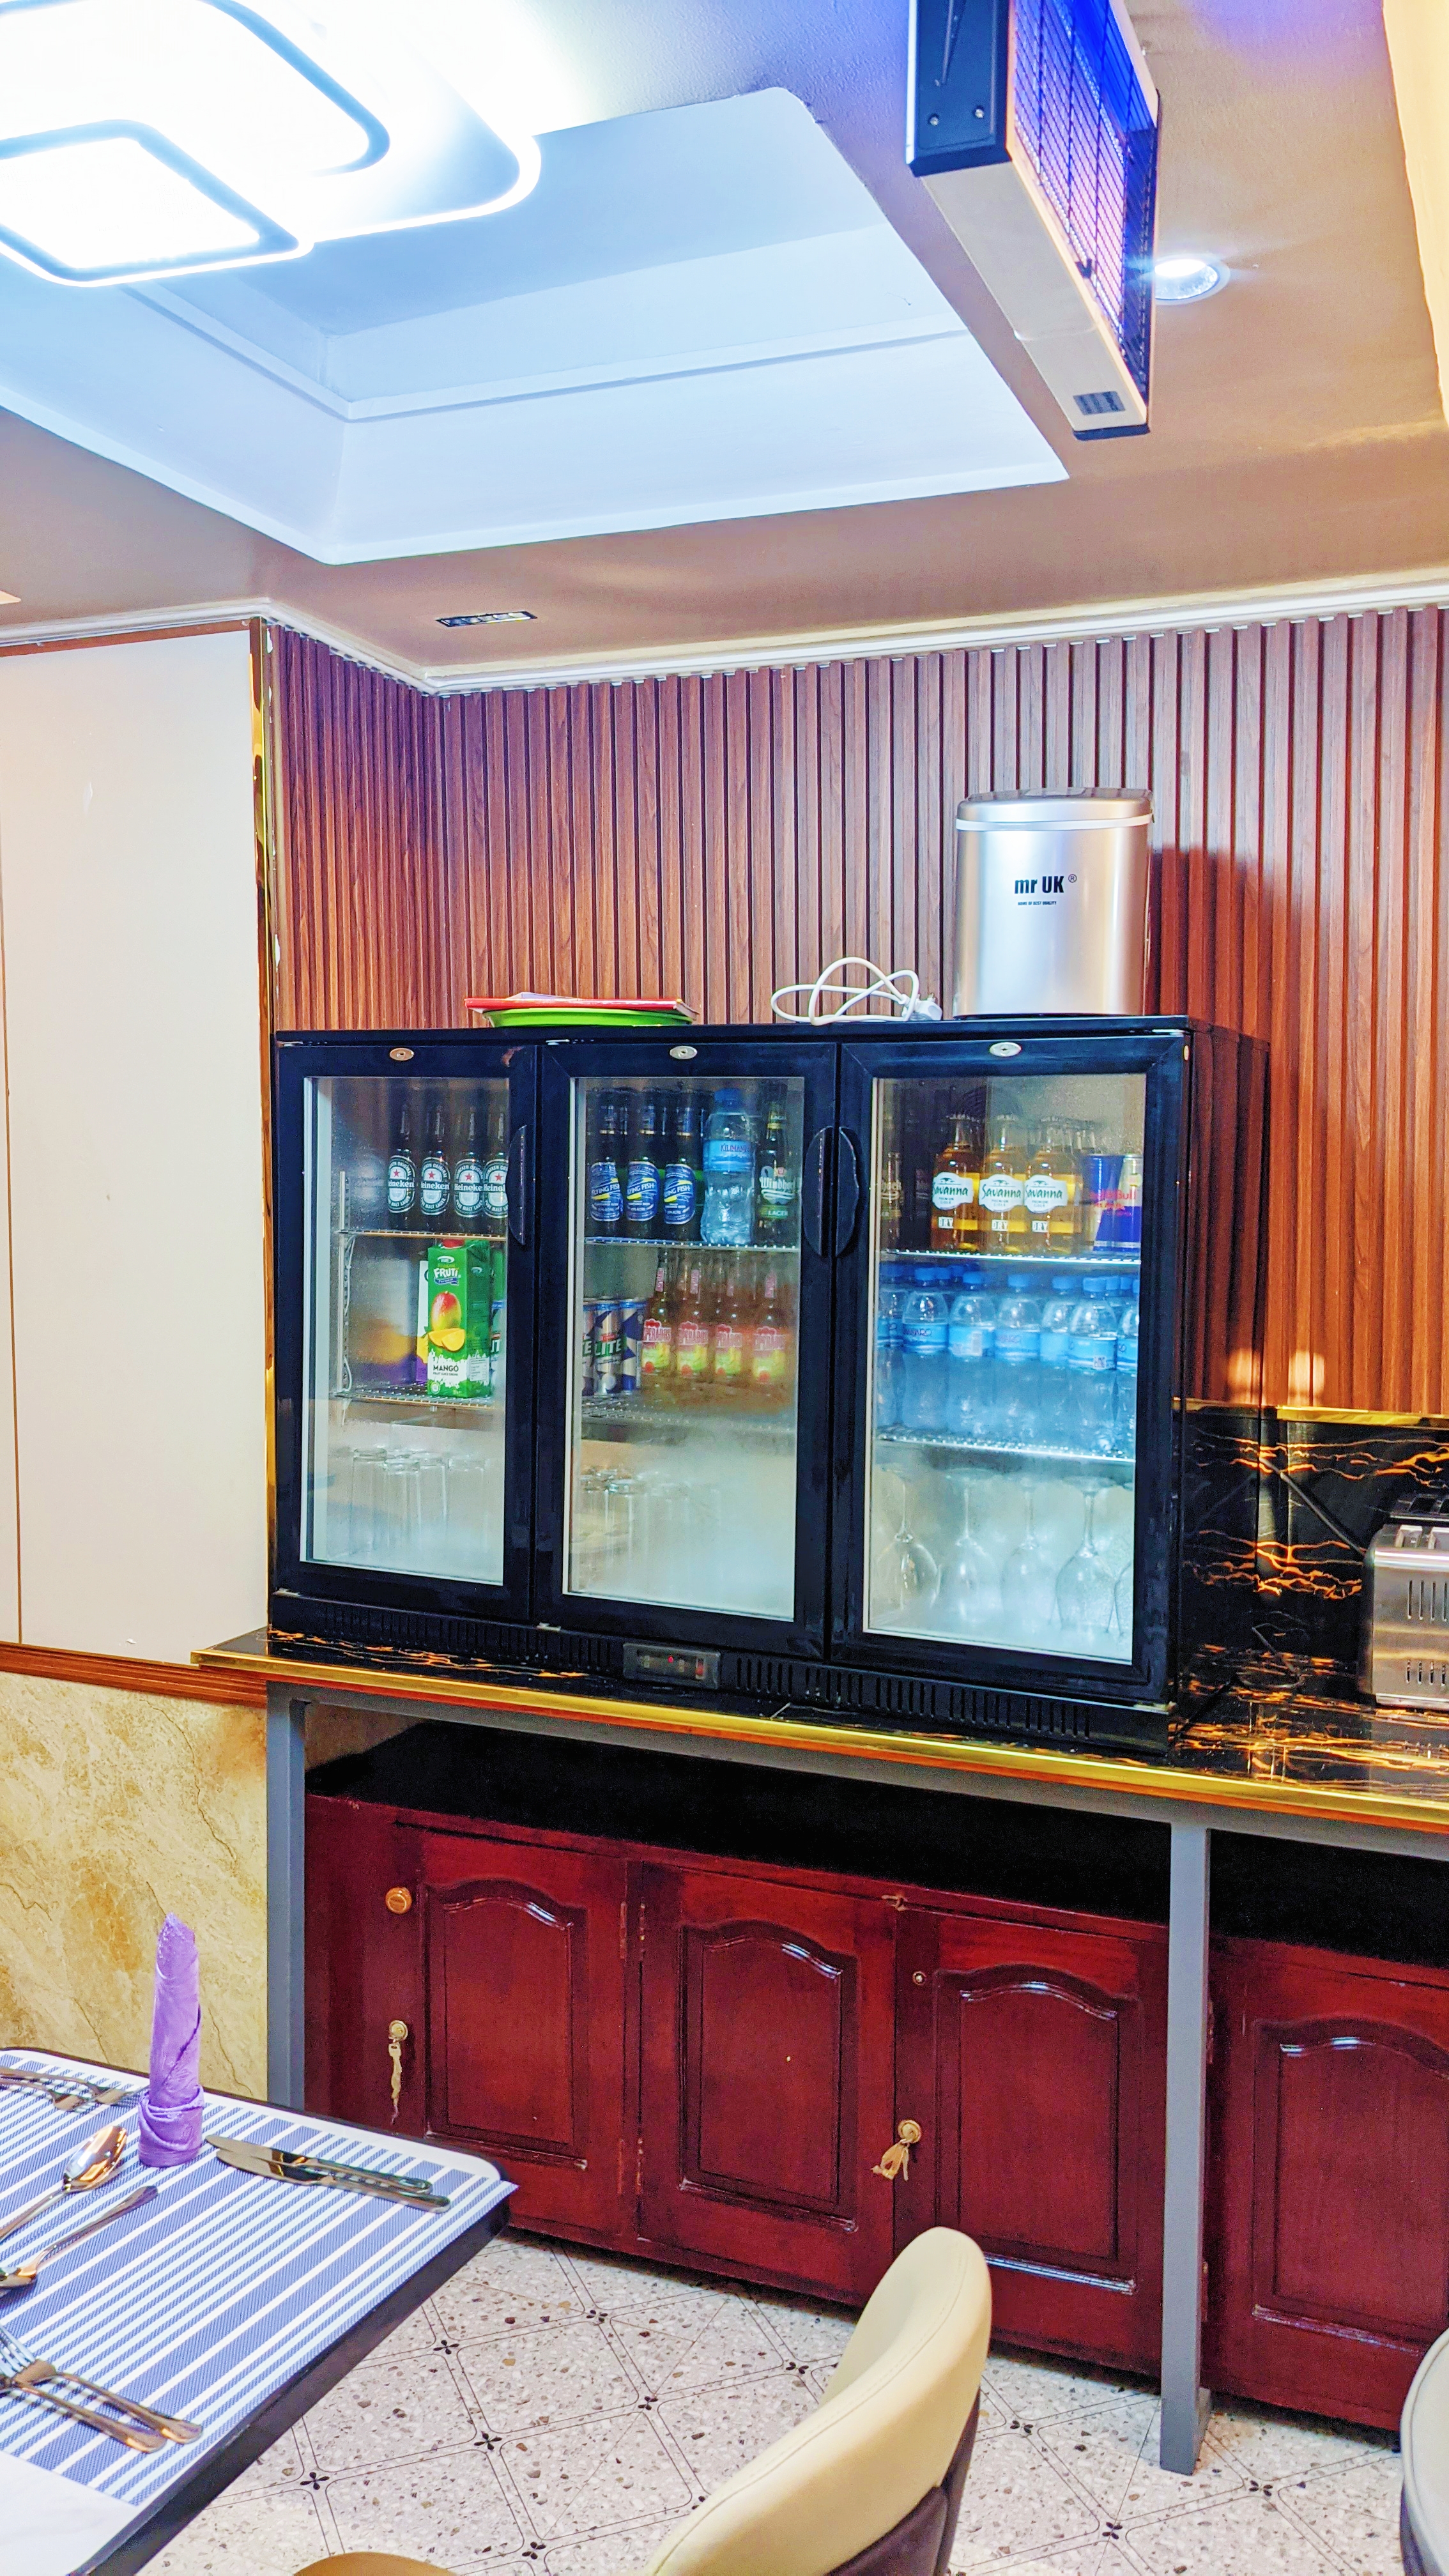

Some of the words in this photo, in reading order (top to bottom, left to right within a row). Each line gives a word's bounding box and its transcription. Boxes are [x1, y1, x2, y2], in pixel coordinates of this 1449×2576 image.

[1015, 879, 1038, 894] mr
[1042, 876, 1064, 893] UK
[982, 1183, 1022, 1200] Savanna
[939, 1217, 953, 1228] DRY
[992, 1220, 1008, 1230] DRY
[1032, 1221, 1048, 1232] DRY
[594, 1338, 622, 1356] LITE
